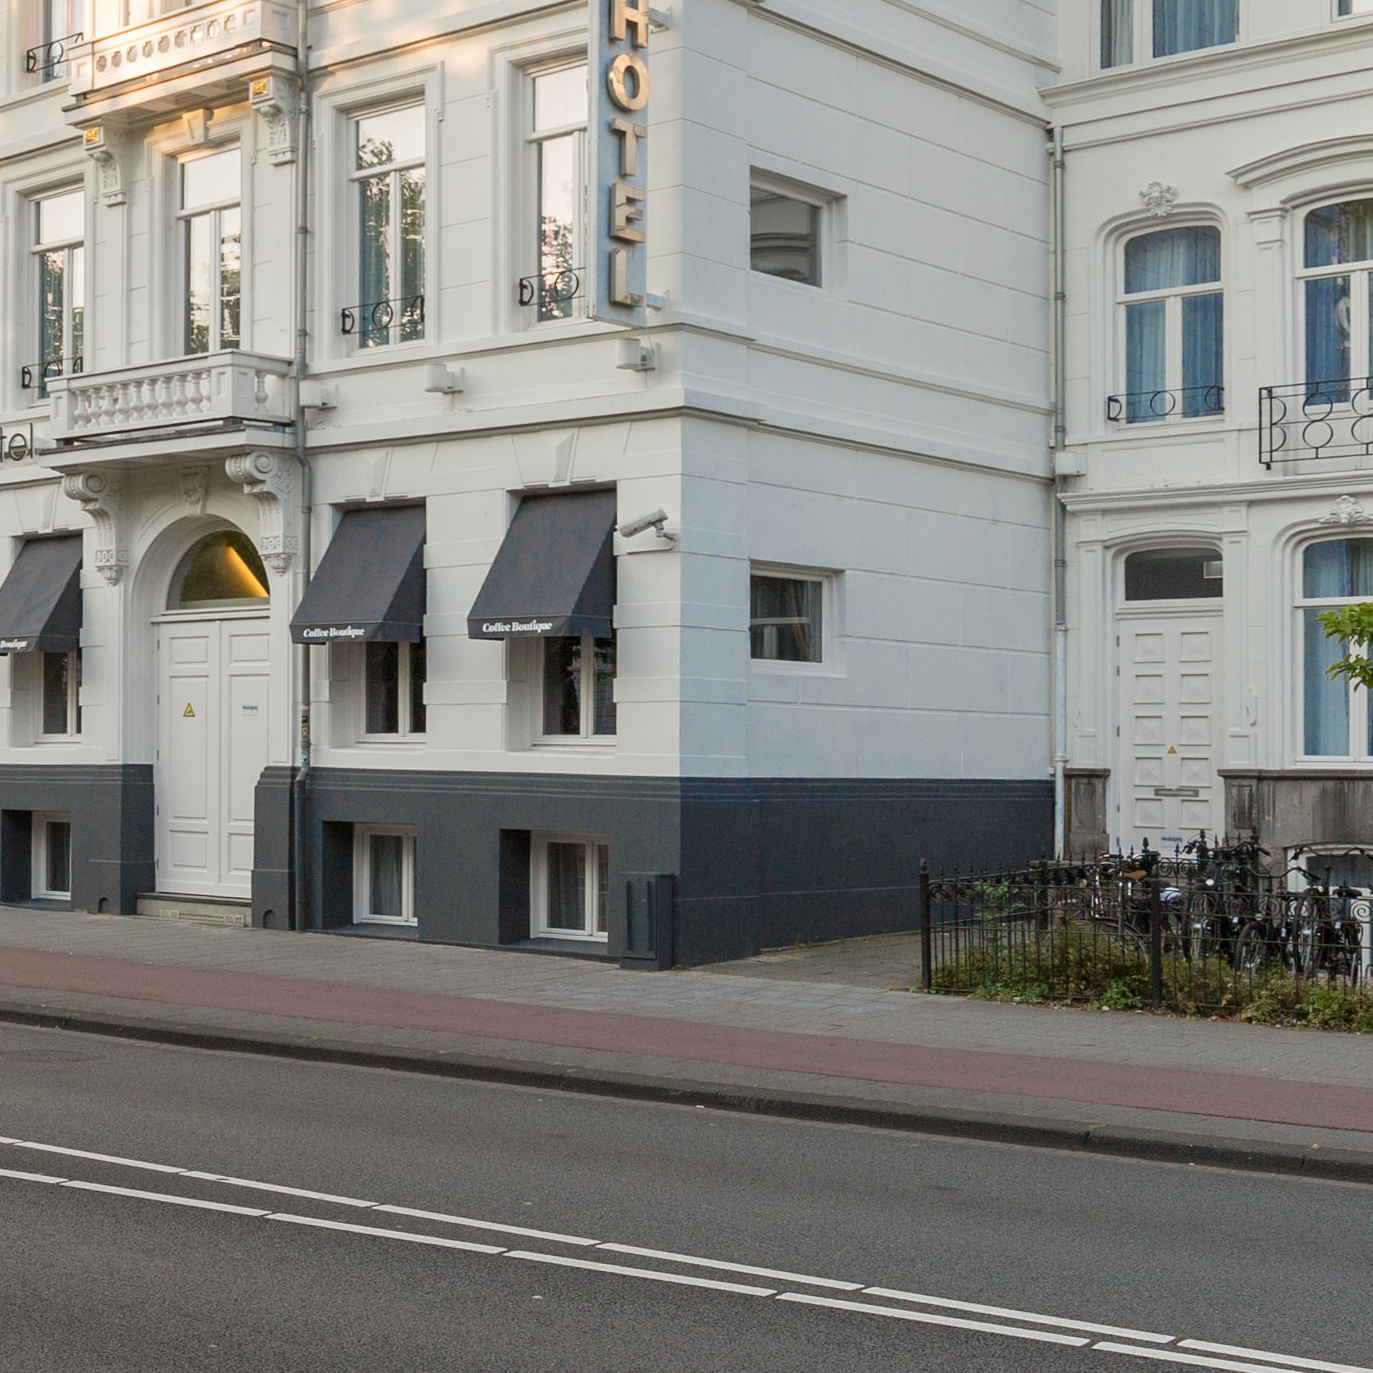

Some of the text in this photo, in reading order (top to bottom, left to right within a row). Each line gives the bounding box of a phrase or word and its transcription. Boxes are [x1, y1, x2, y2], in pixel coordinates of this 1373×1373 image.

[303, 625, 365, 639] Coffee Boutique
[482, 619, 553, 634] Coffee Boutique
